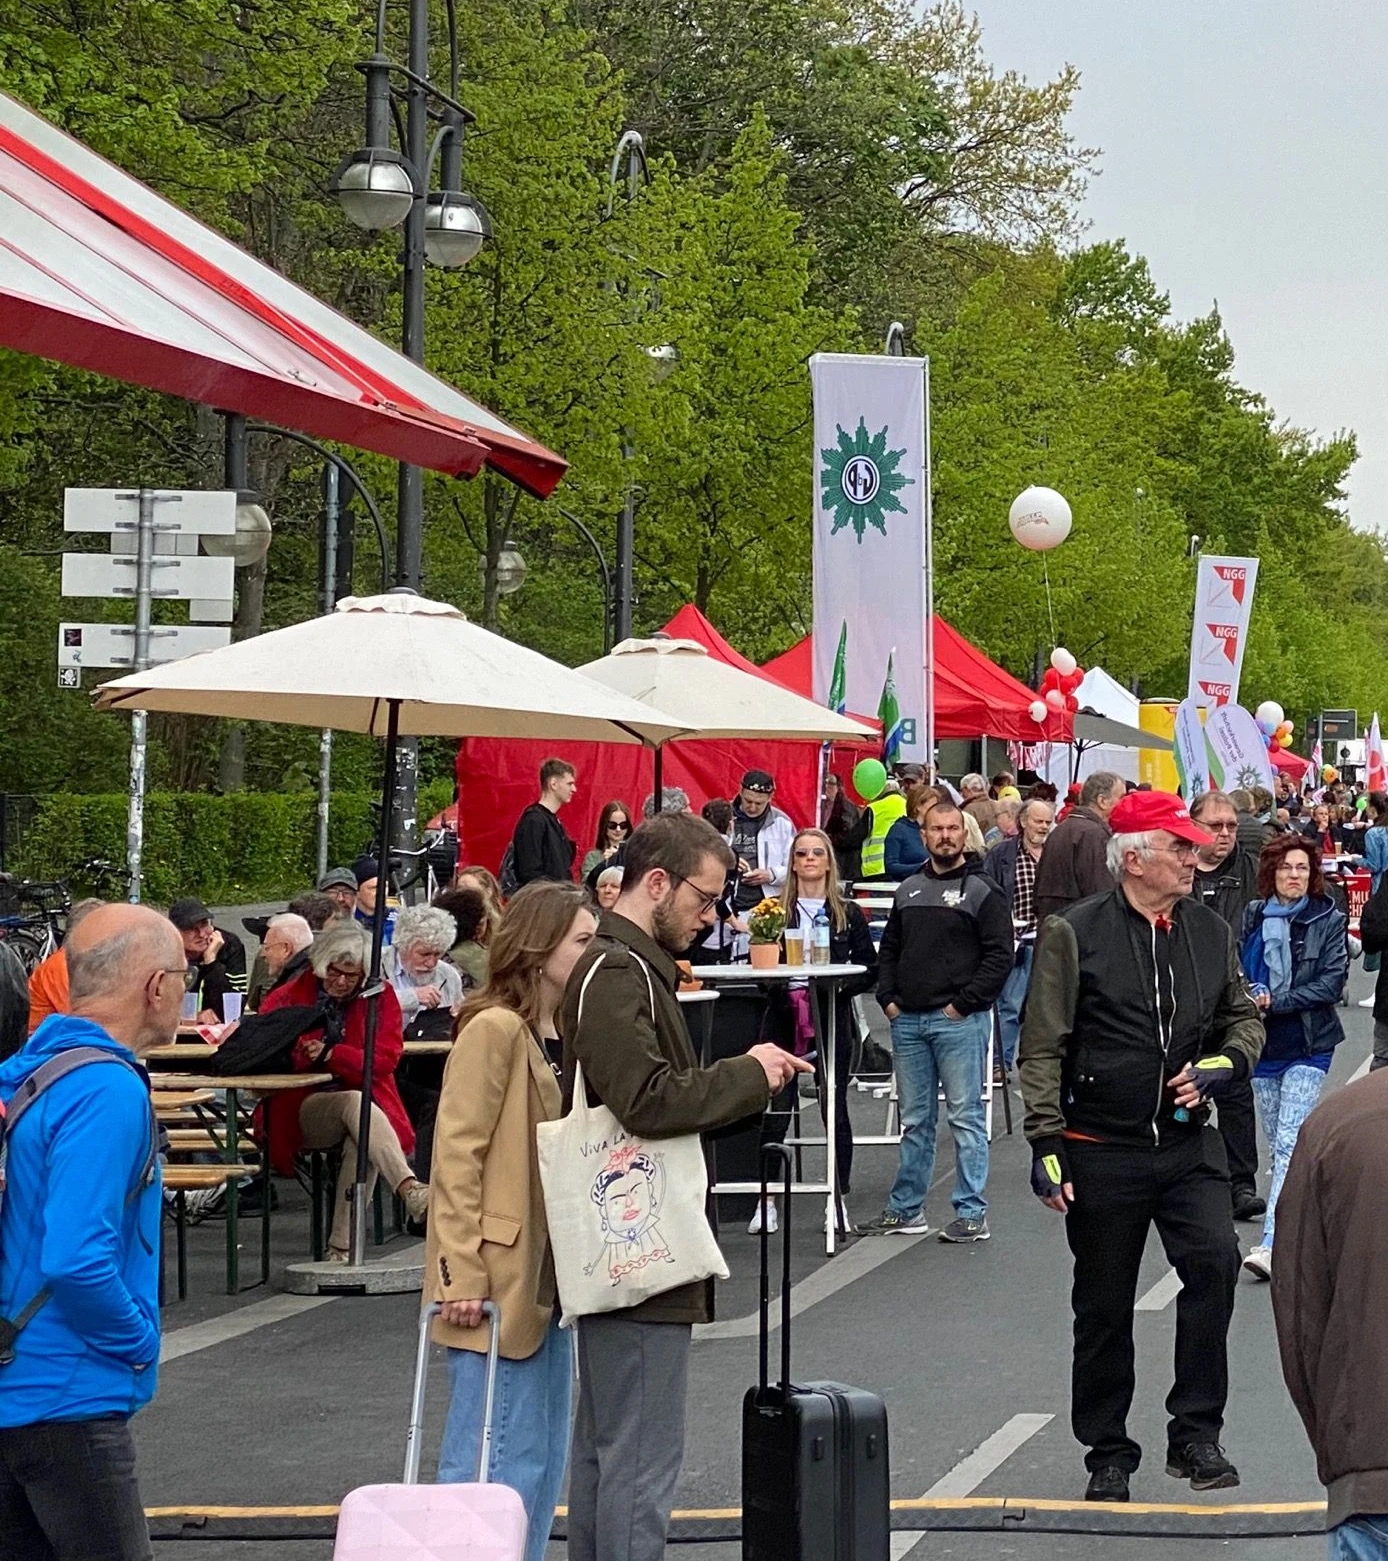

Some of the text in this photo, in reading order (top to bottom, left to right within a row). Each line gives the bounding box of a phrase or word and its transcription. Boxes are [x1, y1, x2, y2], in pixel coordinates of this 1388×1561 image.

[1223, 567, 1246, 580] NGG
[1215, 626, 1238, 638] NGG
[1207, 684, 1230, 696] NGG
[613, 1133, 625, 1145] LA
